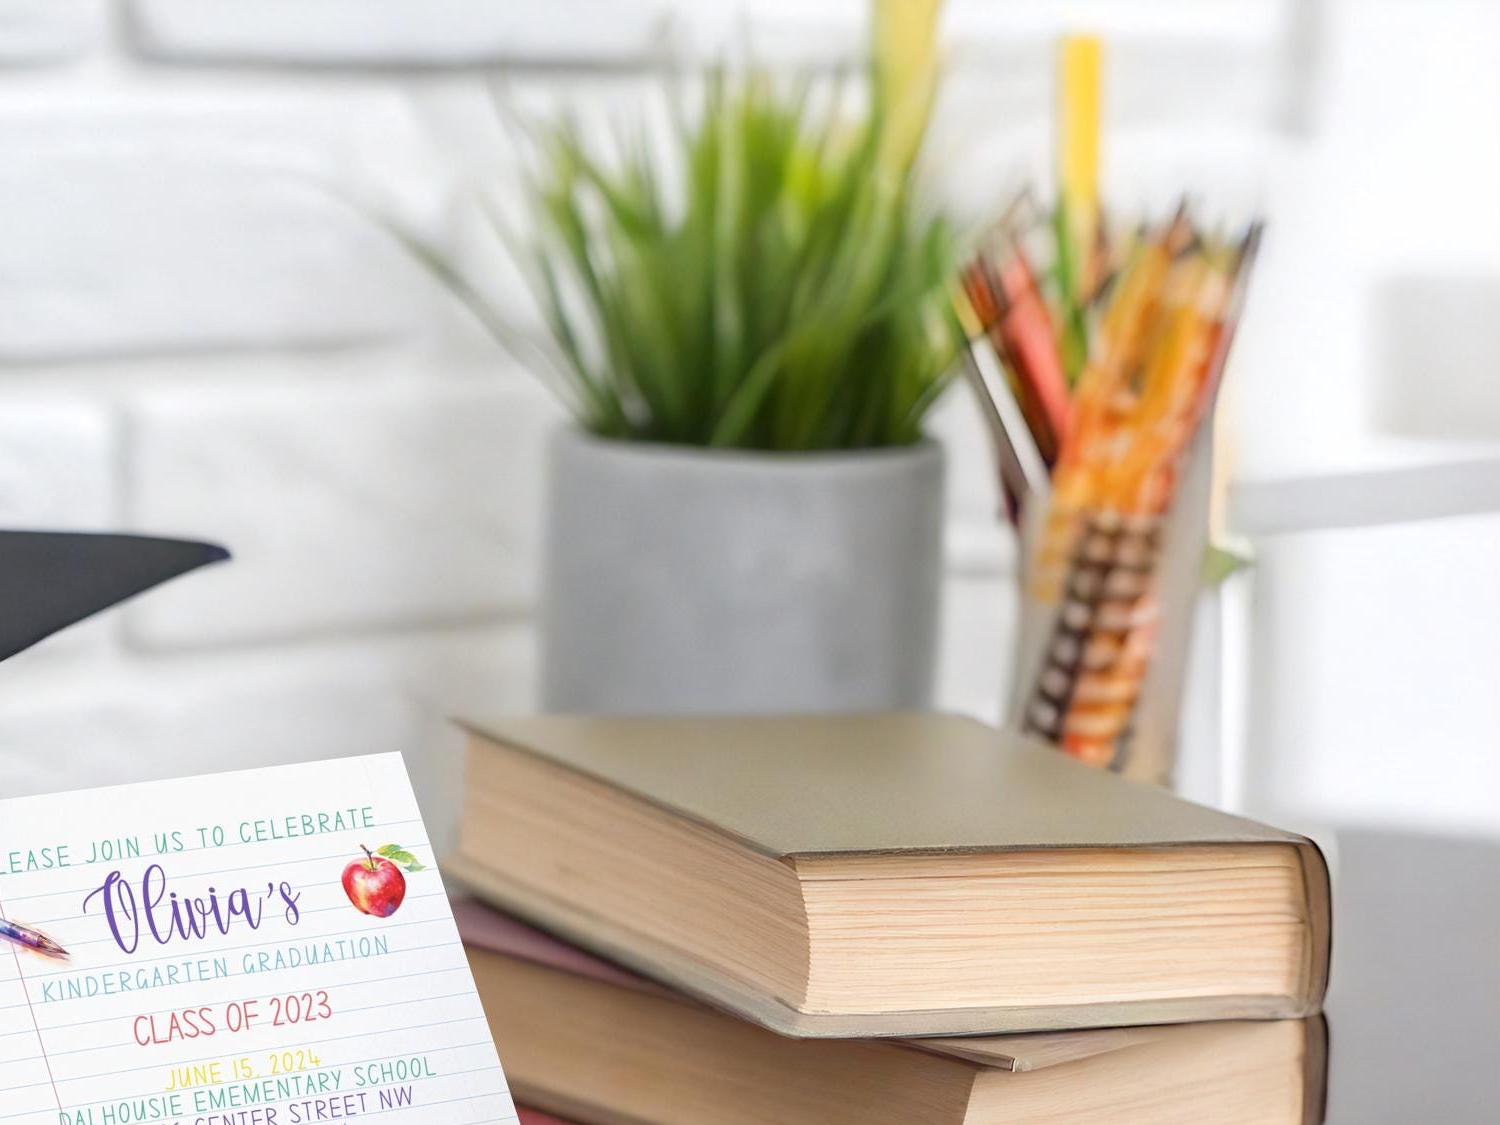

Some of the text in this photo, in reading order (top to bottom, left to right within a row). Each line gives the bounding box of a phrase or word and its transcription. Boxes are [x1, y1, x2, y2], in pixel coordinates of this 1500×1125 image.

[86, 836, 140, 864] JOIN
[154, 831, 184, 853] US
[197, 825, 225, 849] TO
[239, 807, 375, 844] CELEBRATE
[83, 864, 301, 955] Olivia's
[42, 935, 389, 1003] KINDERGARTEN GRADUATION
[133, 991, 332, 1047] CLASS OF 2023
[165, 1062, 223, 1091] JUNE
[270, 1049, 321, 1075] 2024
[195, 1074, 341, 1111] EMEMENTARY
[355, 1057, 436, 1086] SCHOOL
[290, 1093, 368, 1122] STREET
[380, 1086, 412, 1108] NW
